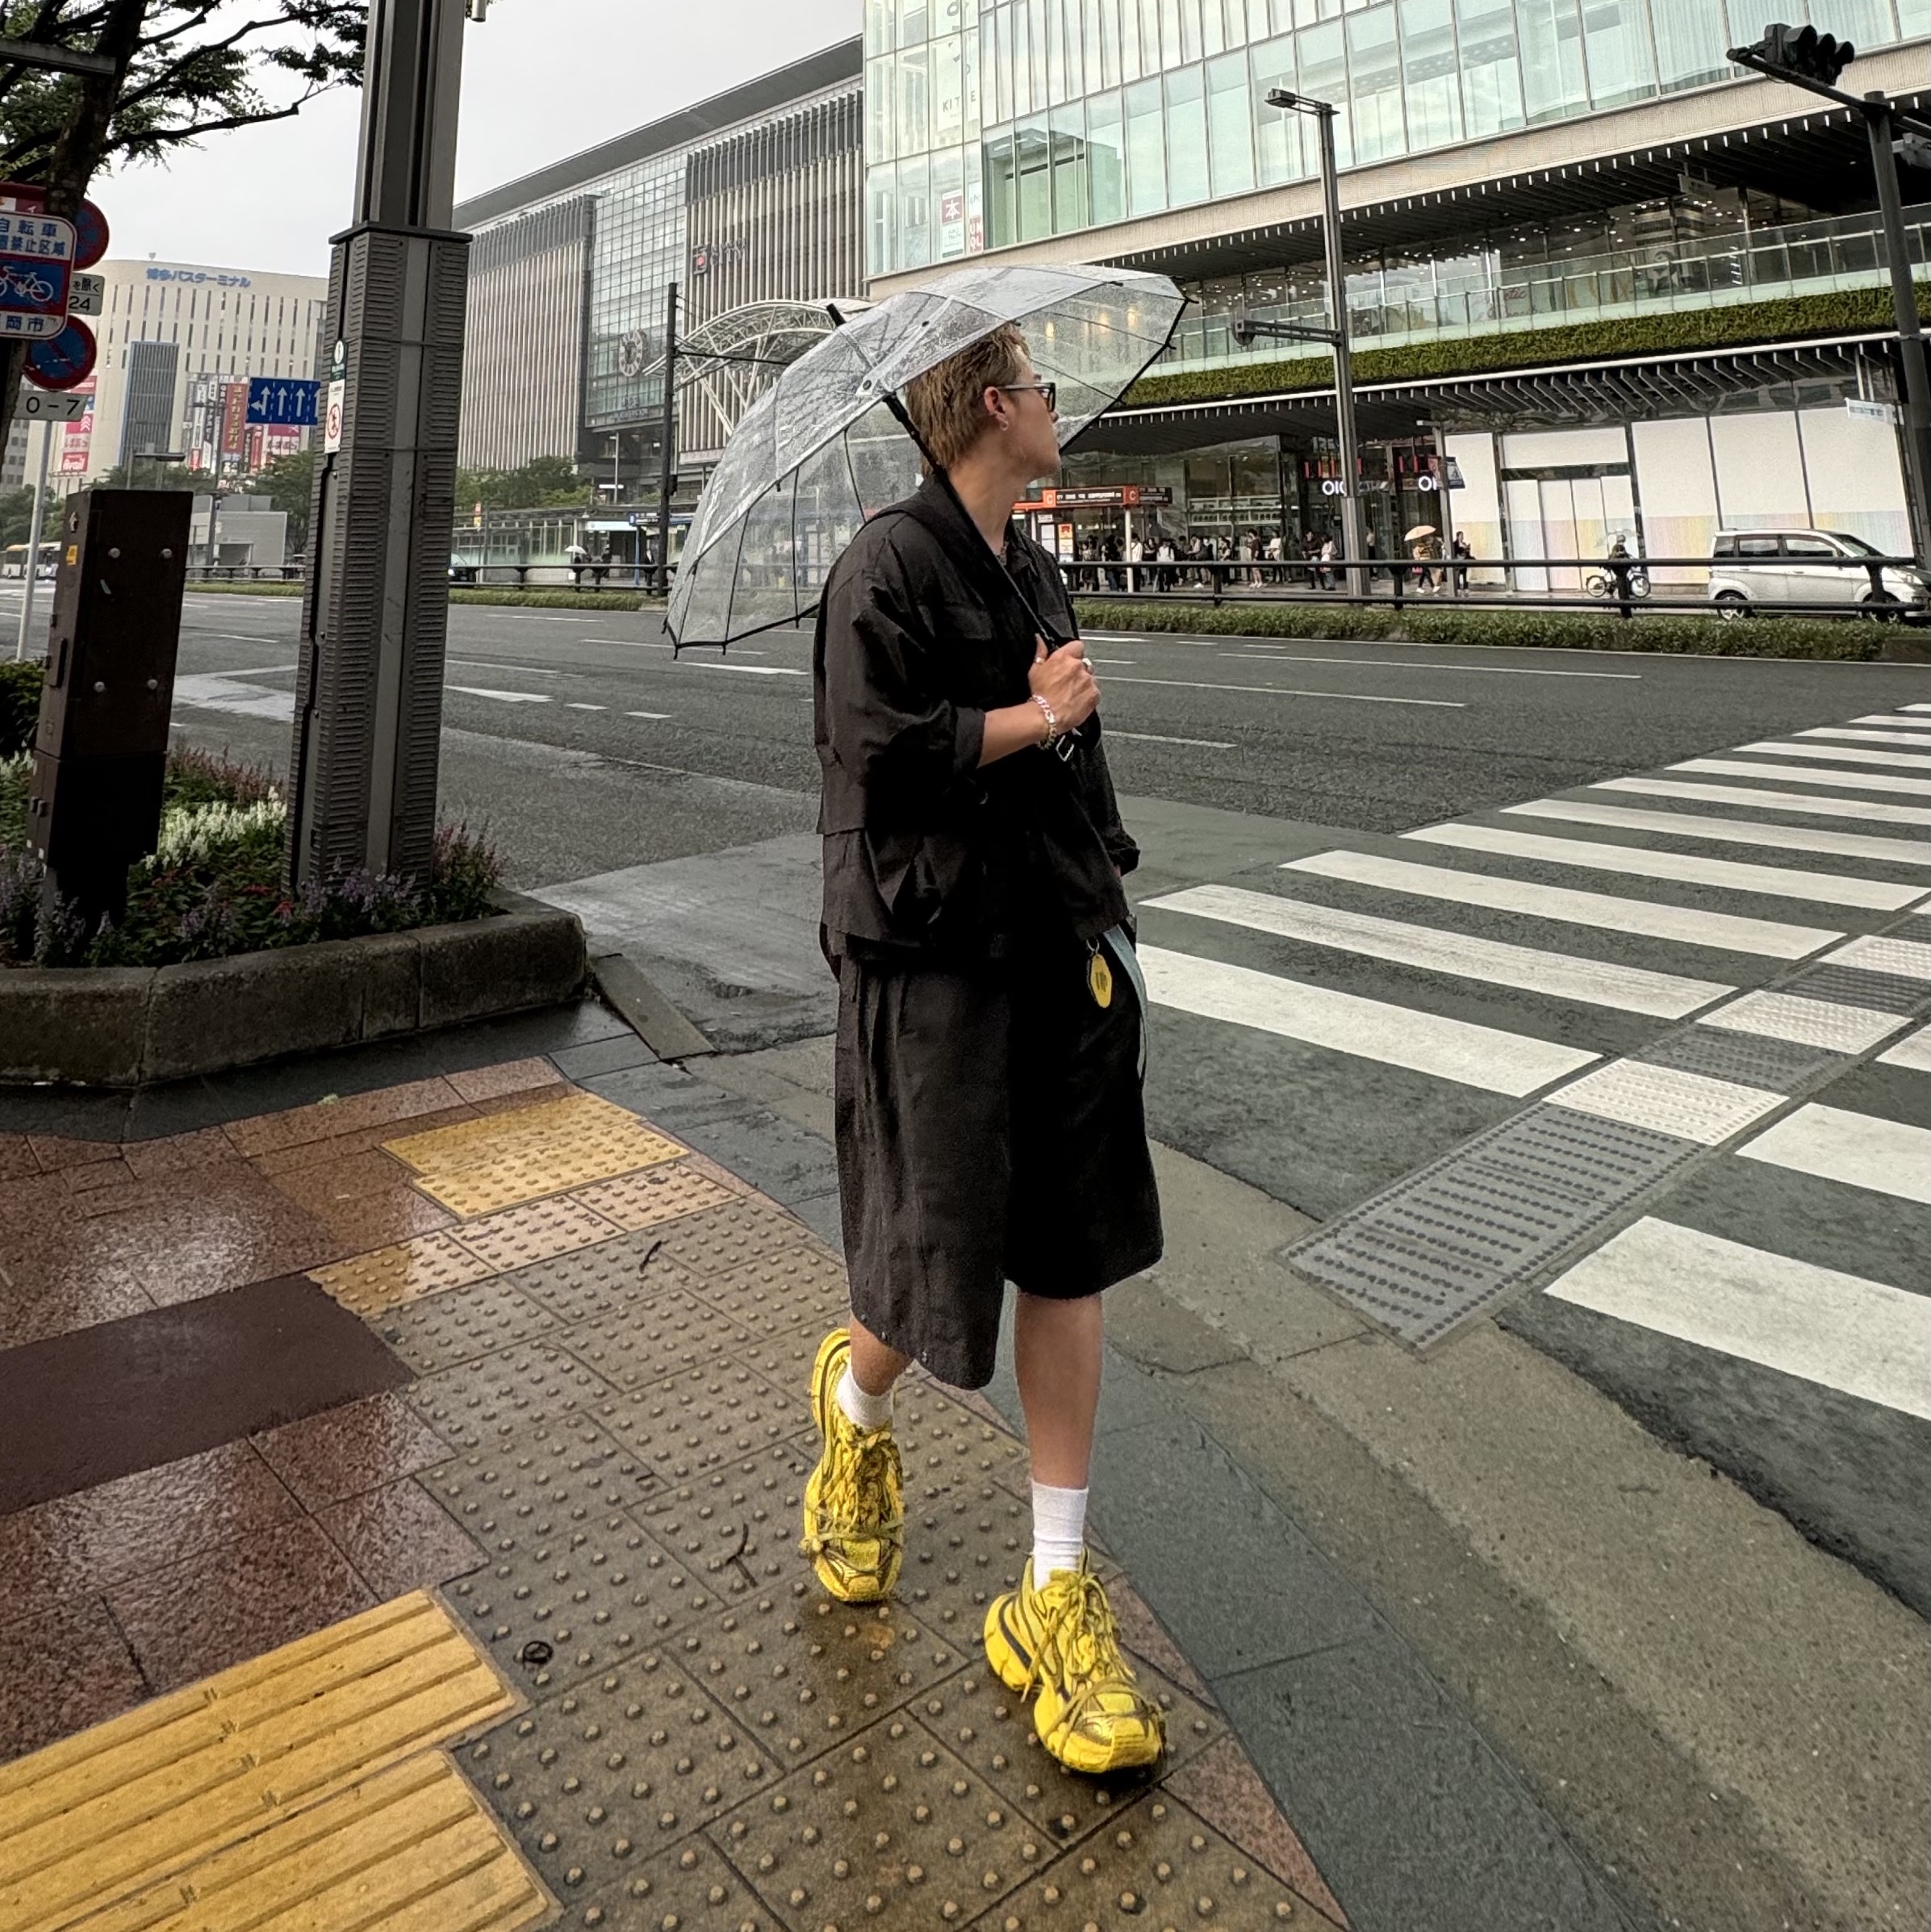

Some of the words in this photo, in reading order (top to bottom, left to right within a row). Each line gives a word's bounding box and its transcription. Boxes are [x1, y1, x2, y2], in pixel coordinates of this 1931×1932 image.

[0, 218, 57, 236] 自転車
[146, 267, 251, 288] 博多バスターミナル
